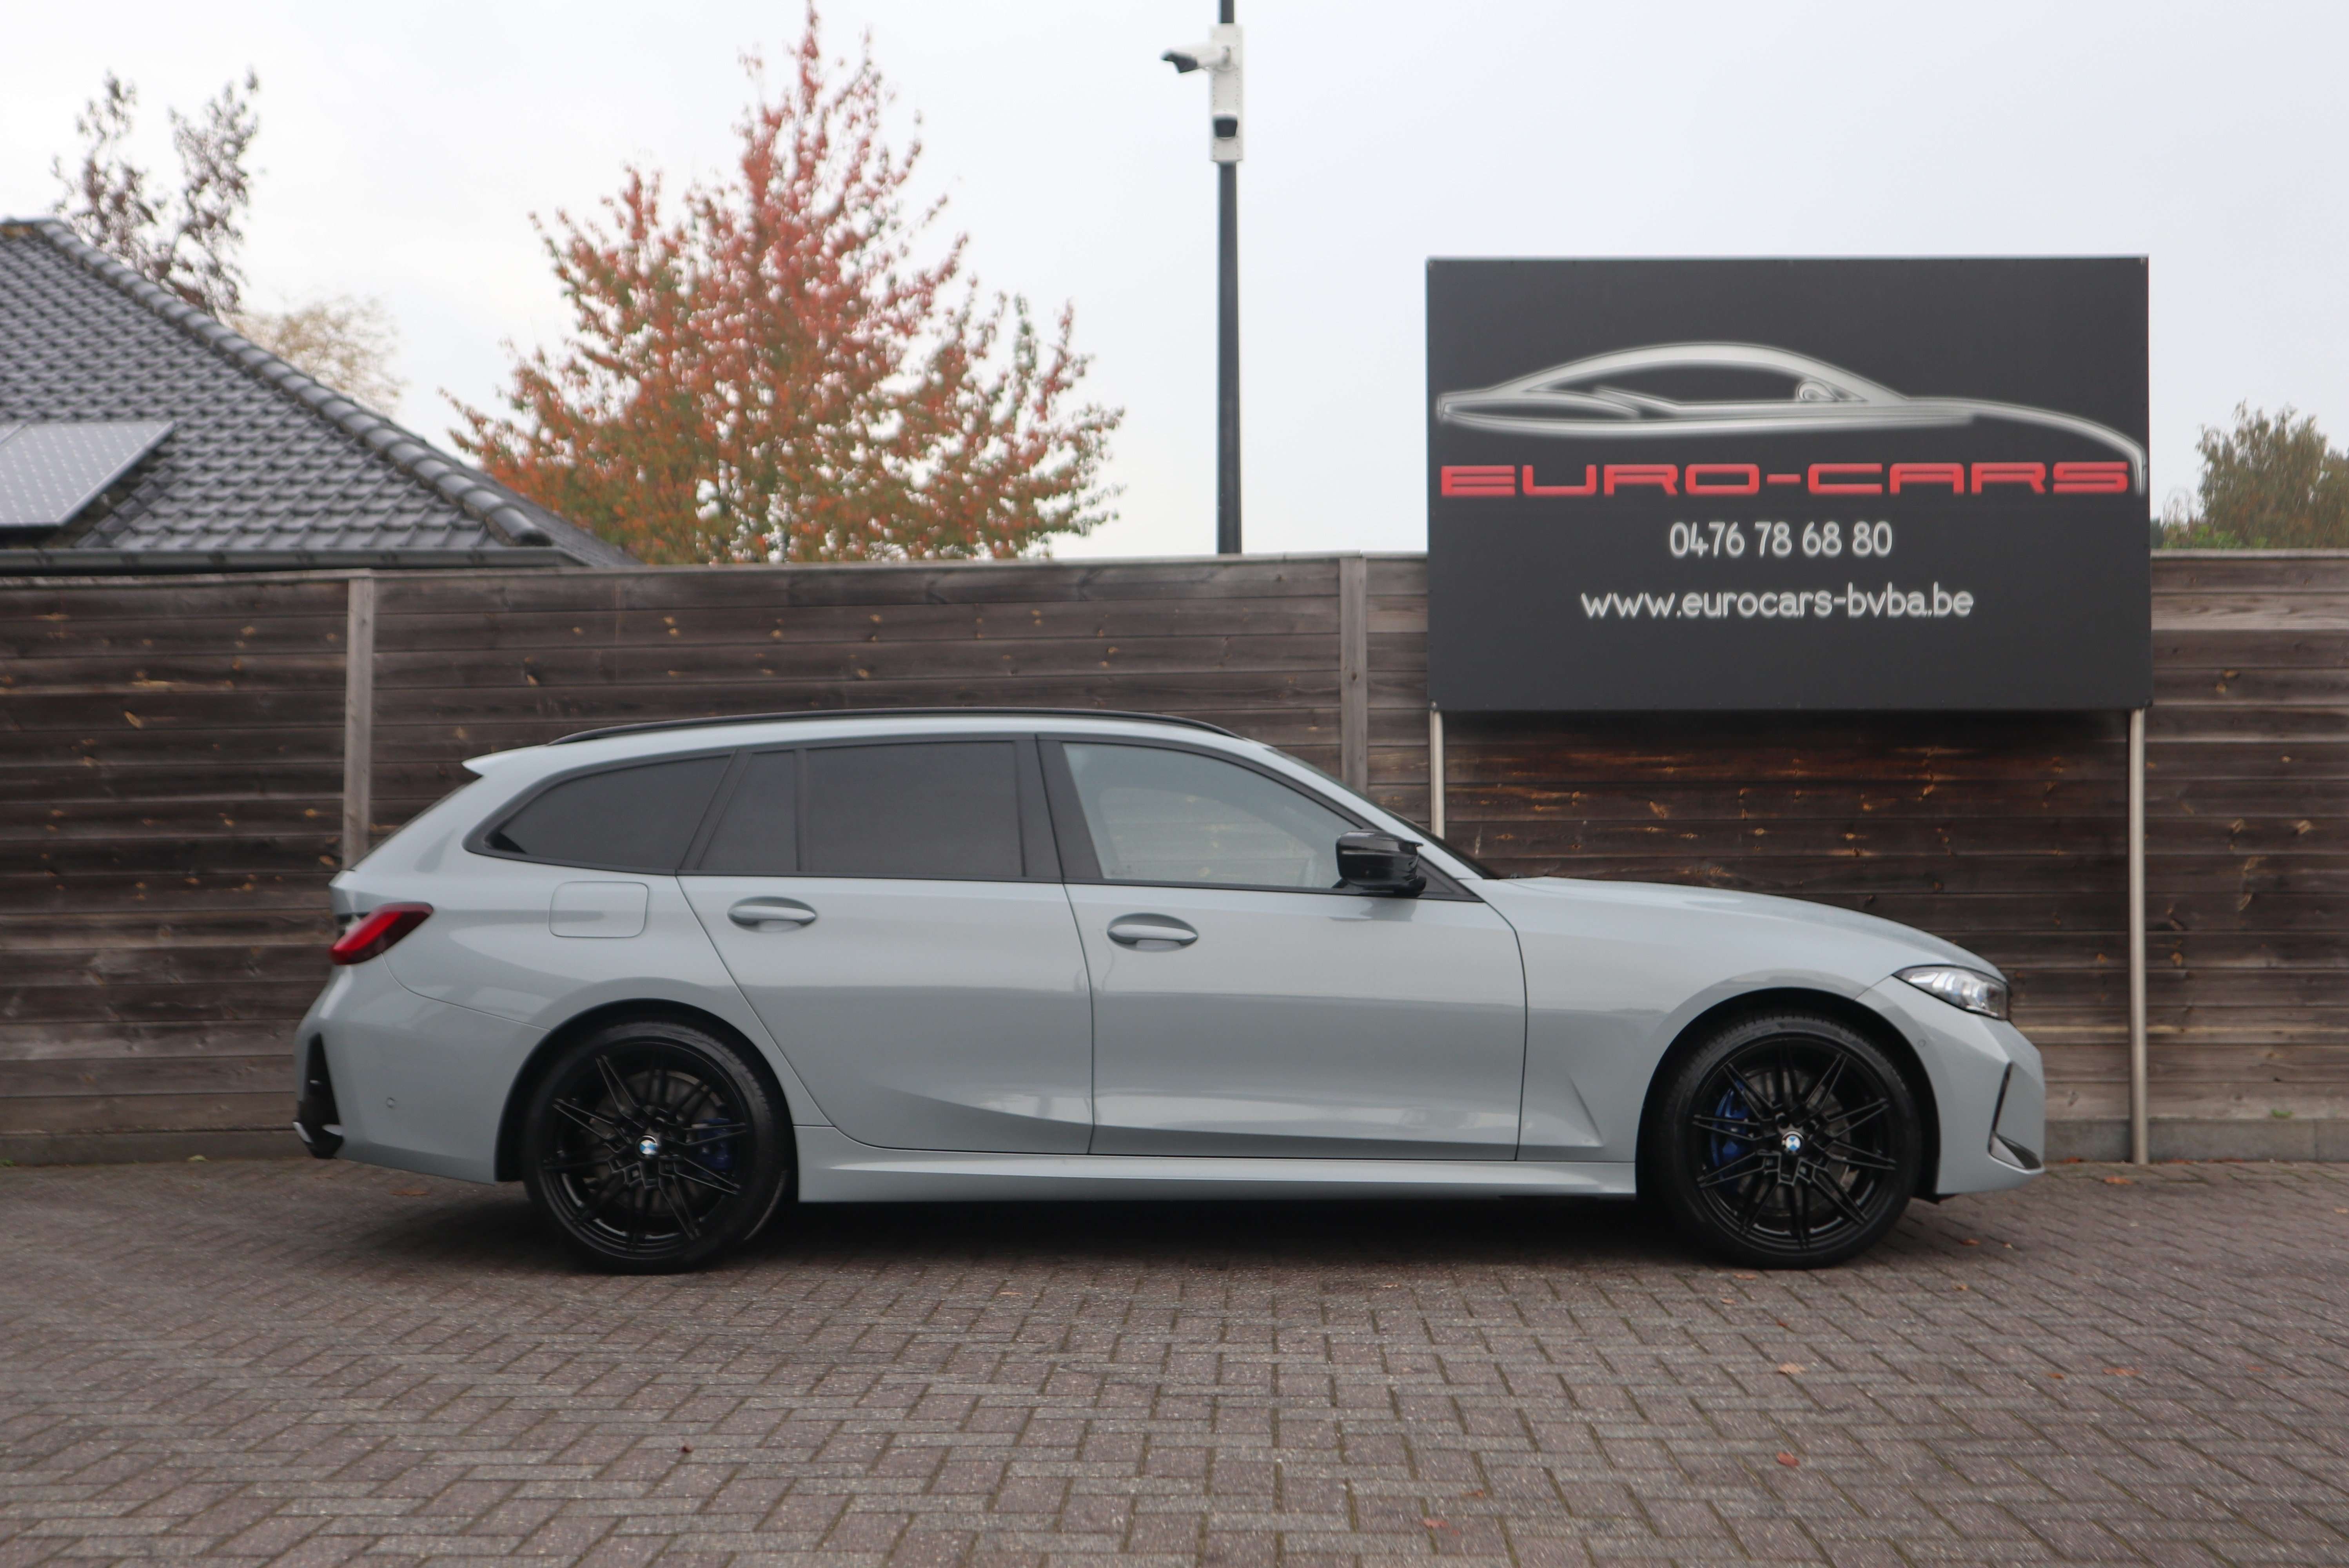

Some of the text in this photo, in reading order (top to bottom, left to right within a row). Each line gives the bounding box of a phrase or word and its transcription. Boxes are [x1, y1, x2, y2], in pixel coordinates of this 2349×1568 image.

[1441, 462, 2129, 497] EURO-CARS
[1670, 521, 1892, 557] 0476 78 68 80
[1581, 582, 1973, 617] www.eurocars-bvba.be
